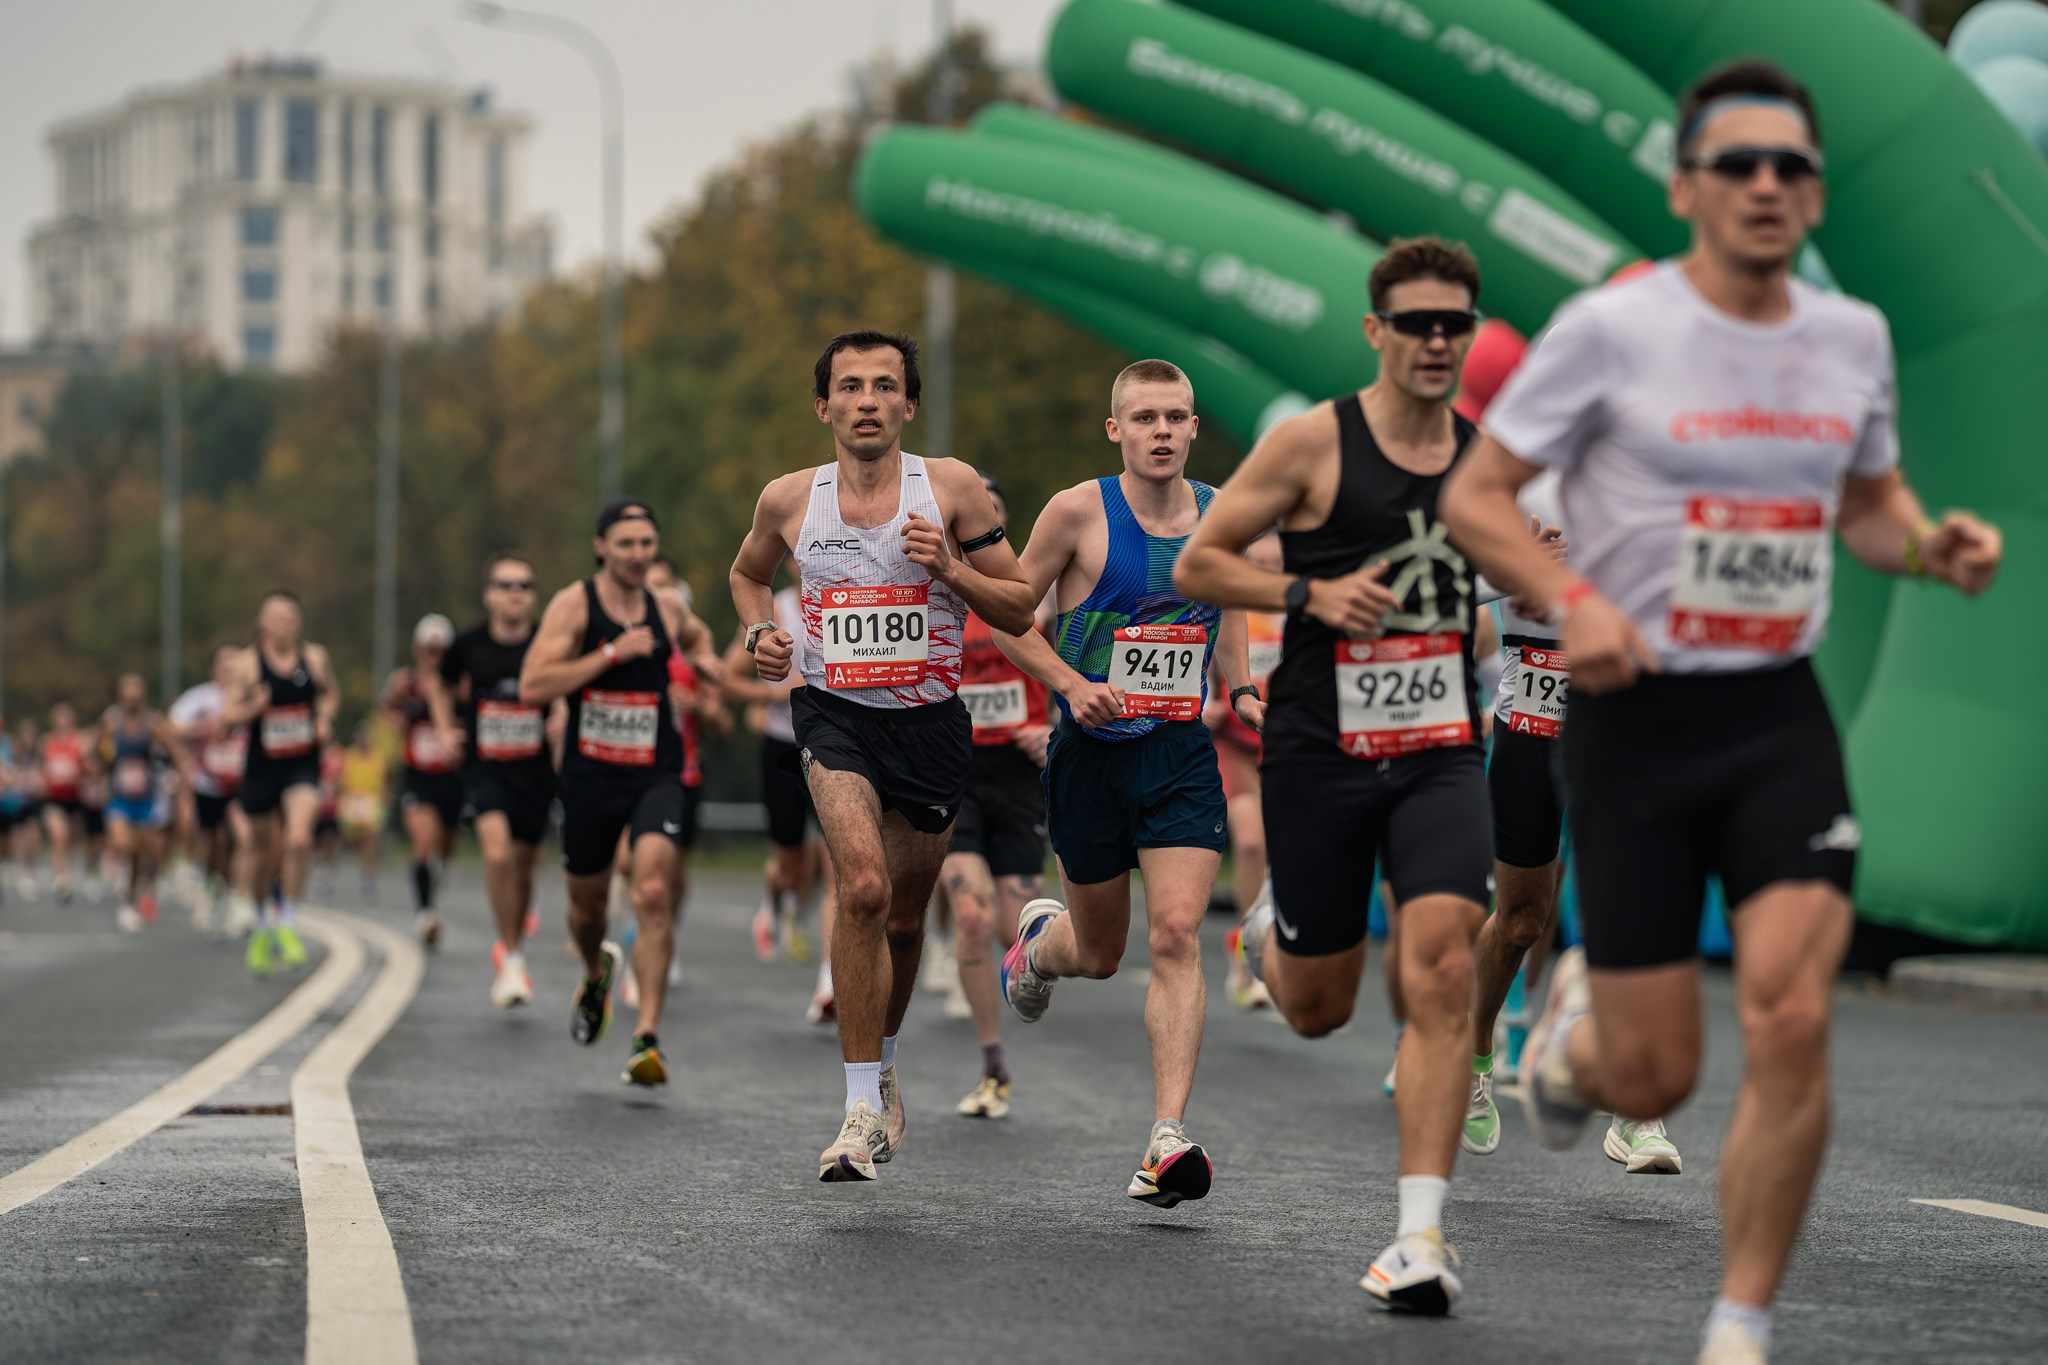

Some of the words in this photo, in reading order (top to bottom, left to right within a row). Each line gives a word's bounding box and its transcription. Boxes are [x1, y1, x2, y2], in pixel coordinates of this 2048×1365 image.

[1670, 402, 1855, 444] СТОЙКОСТЬ
[808, 539, 861, 551] ARC
[827, 612, 924, 645] 10180
[853, 646, 896, 657] МИХАИЛ
[1125, 648, 1193, 679] 9419
[1140, 681, 1174, 691] ВАДИМ
[1356, 665, 1447, 708] 9266
